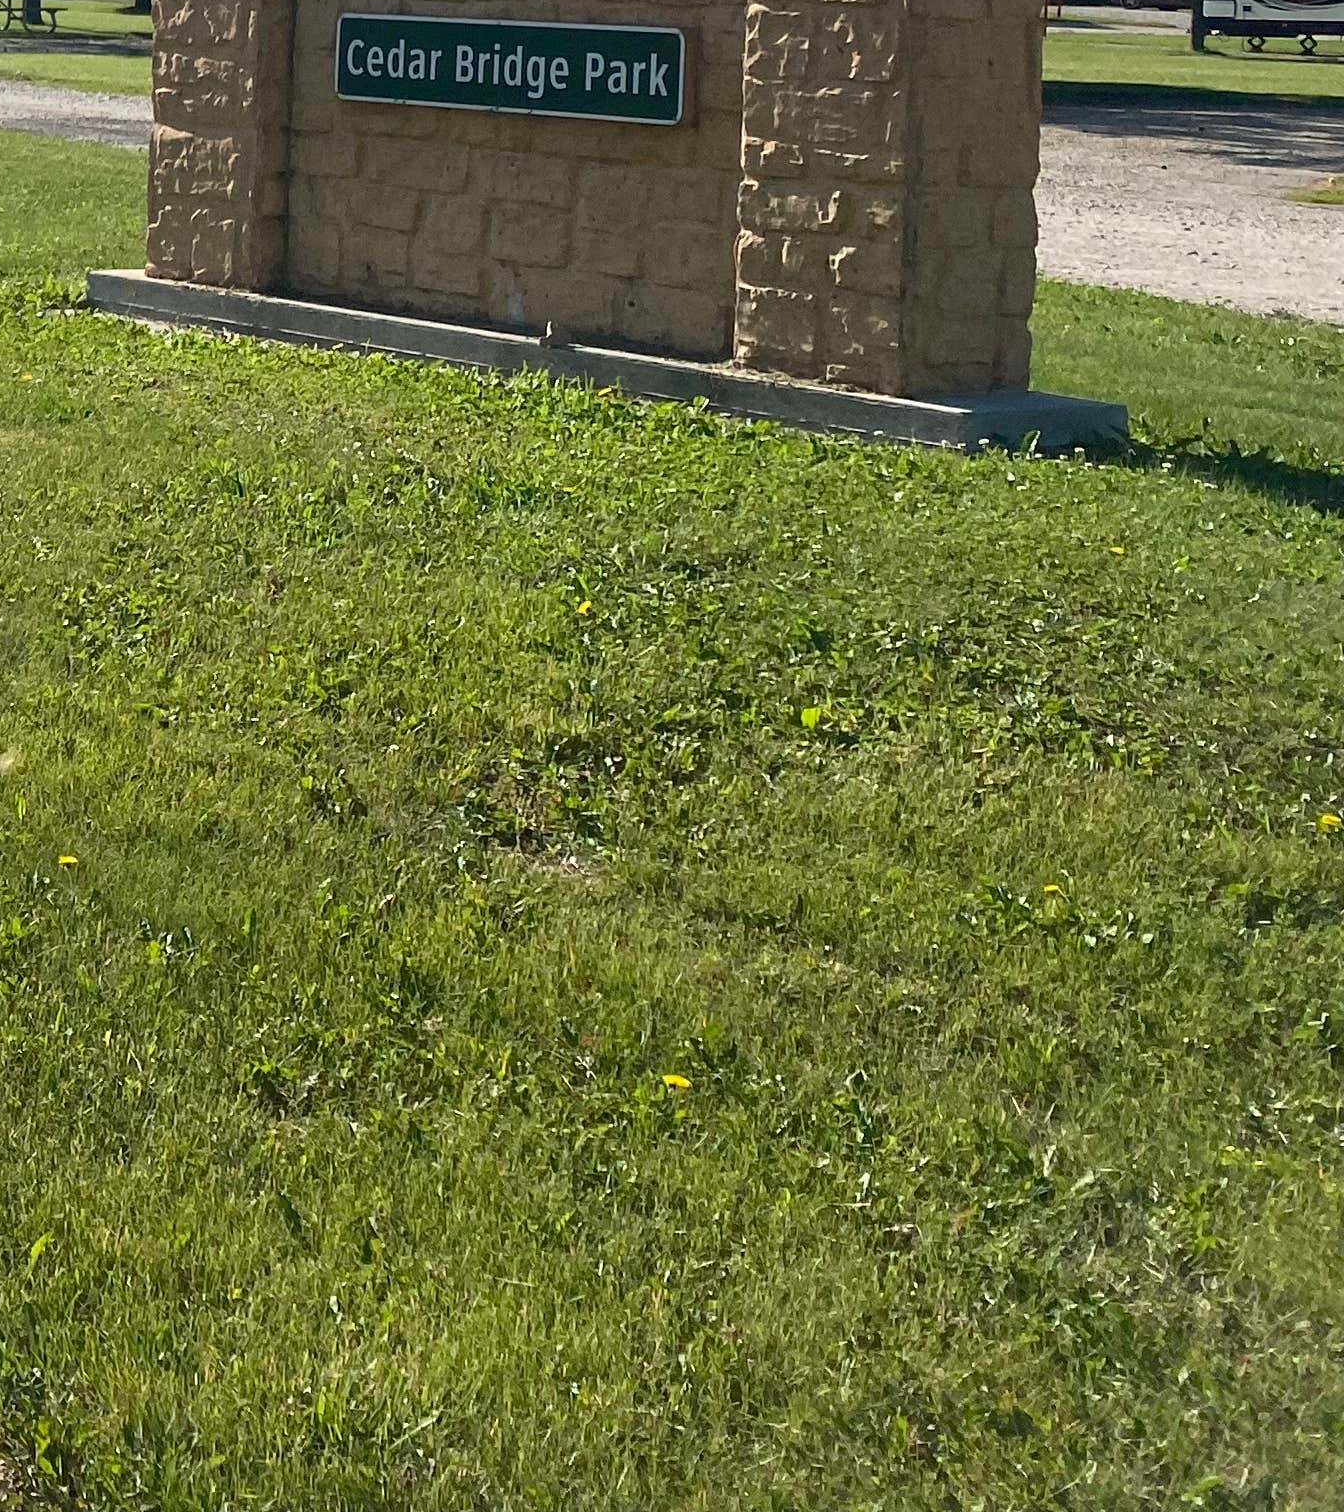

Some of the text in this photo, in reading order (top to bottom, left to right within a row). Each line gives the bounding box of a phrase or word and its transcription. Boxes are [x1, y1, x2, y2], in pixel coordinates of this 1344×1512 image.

[346, 39, 669, 99] Cedar Bridge Park
